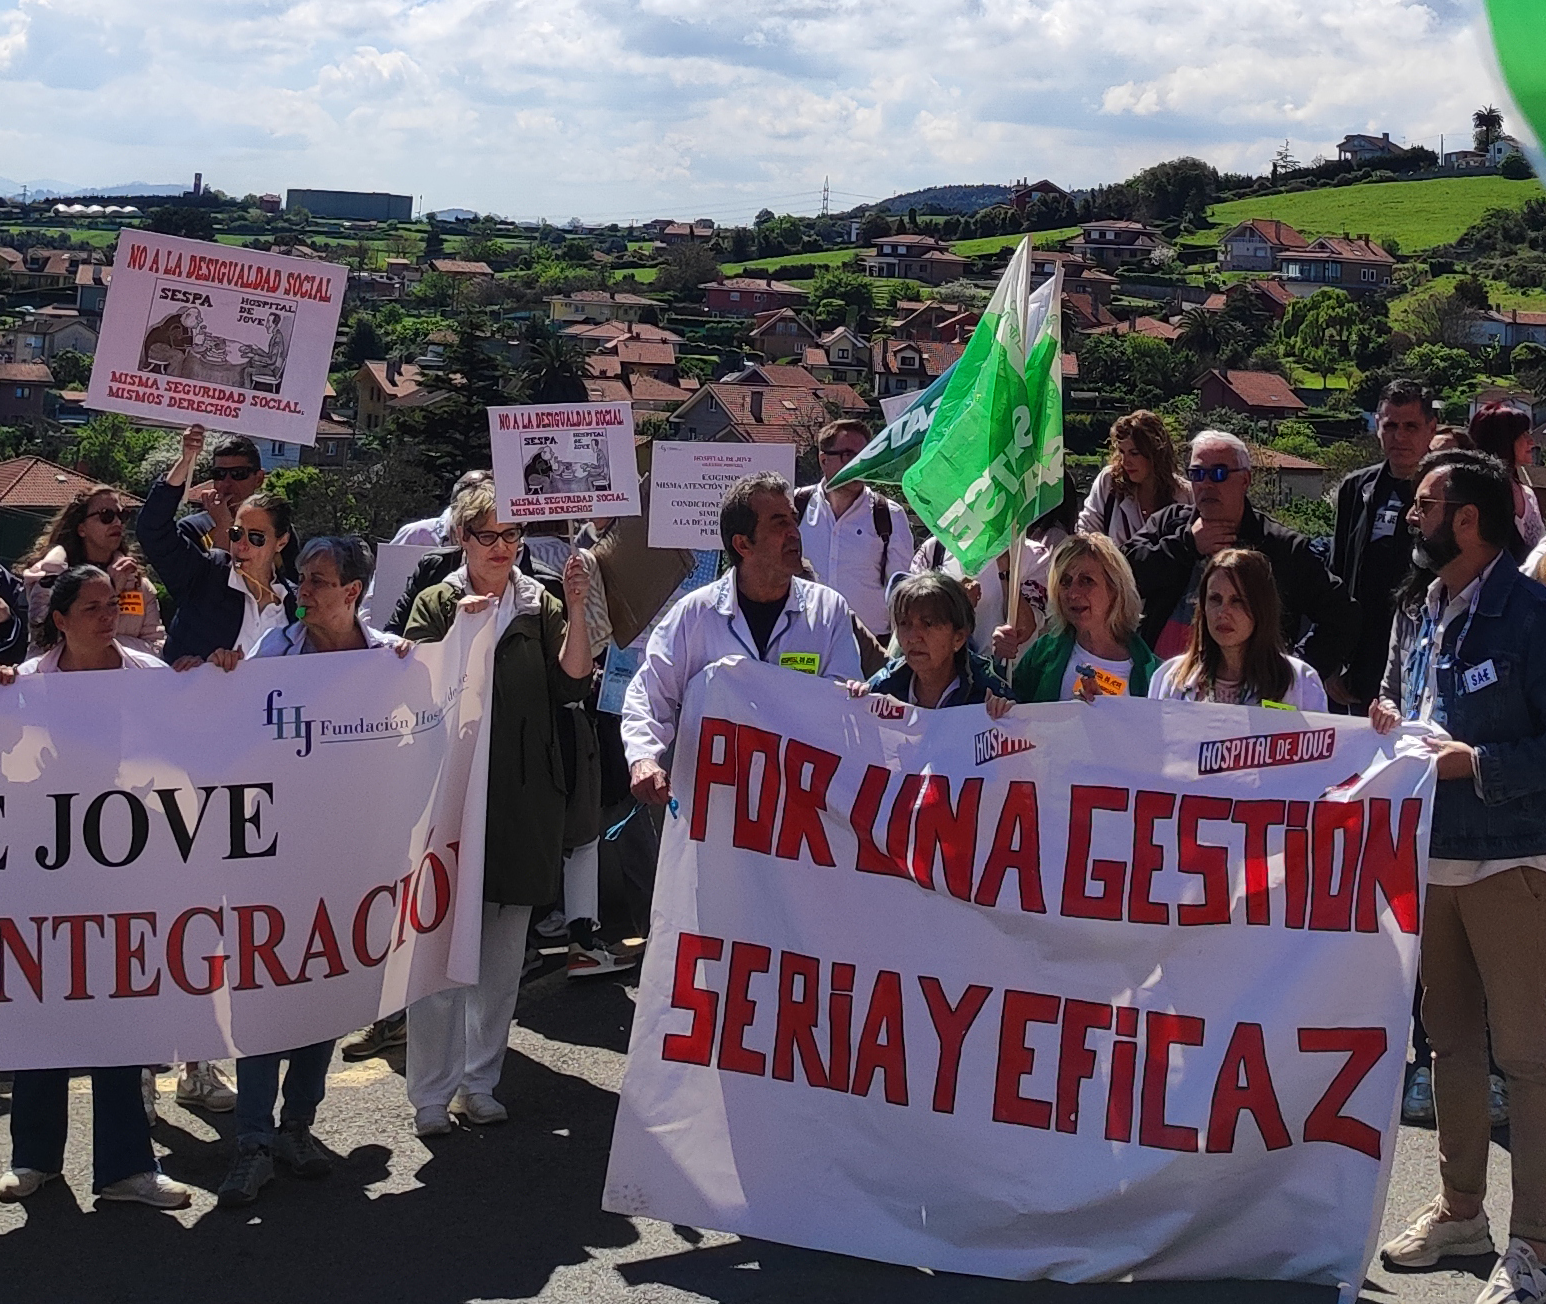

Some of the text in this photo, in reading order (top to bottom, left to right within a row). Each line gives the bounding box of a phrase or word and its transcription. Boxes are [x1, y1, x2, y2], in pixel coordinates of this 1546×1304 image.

[127, 243, 333, 303] NO A LA DESIGUALDAD SOCIAL
[159, 287, 213, 308] SESPA
[240, 296, 296, 314] HOSPITAL
[237, 315, 265, 327] JOVE
[238, 306, 255, 315] DE
[110, 370, 159, 391] MISMA
[164, 380, 246, 405] SEGURIDAD
[107, 386, 242, 419] MISMOS DERECHOS
[498, 408, 624, 431] NO A LA DESIGUALDAD SOCIAL
[524, 436, 558, 446] SESPA
[655, 481, 682, 489] MISMA
[510, 497, 541, 507] MISMA
[544, 495, 594, 505] SEGURIDAD
[511, 504, 594, 517] MISMOS DERECHOS
[671, 500, 722, 509] CONDICIONE
[1470, 667, 1491, 687] SAE
[320, 715, 409, 736] Fundación
[1200, 736, 1273, 772] HOSPITAL
[1275, 738, 1293, 761] DE
[689, 717, 842, 868] POR
[849, 762, 1047, 915] UNA
[36, 782, 280, 872] JOVE
[916, 974, 994, 1115] Y
